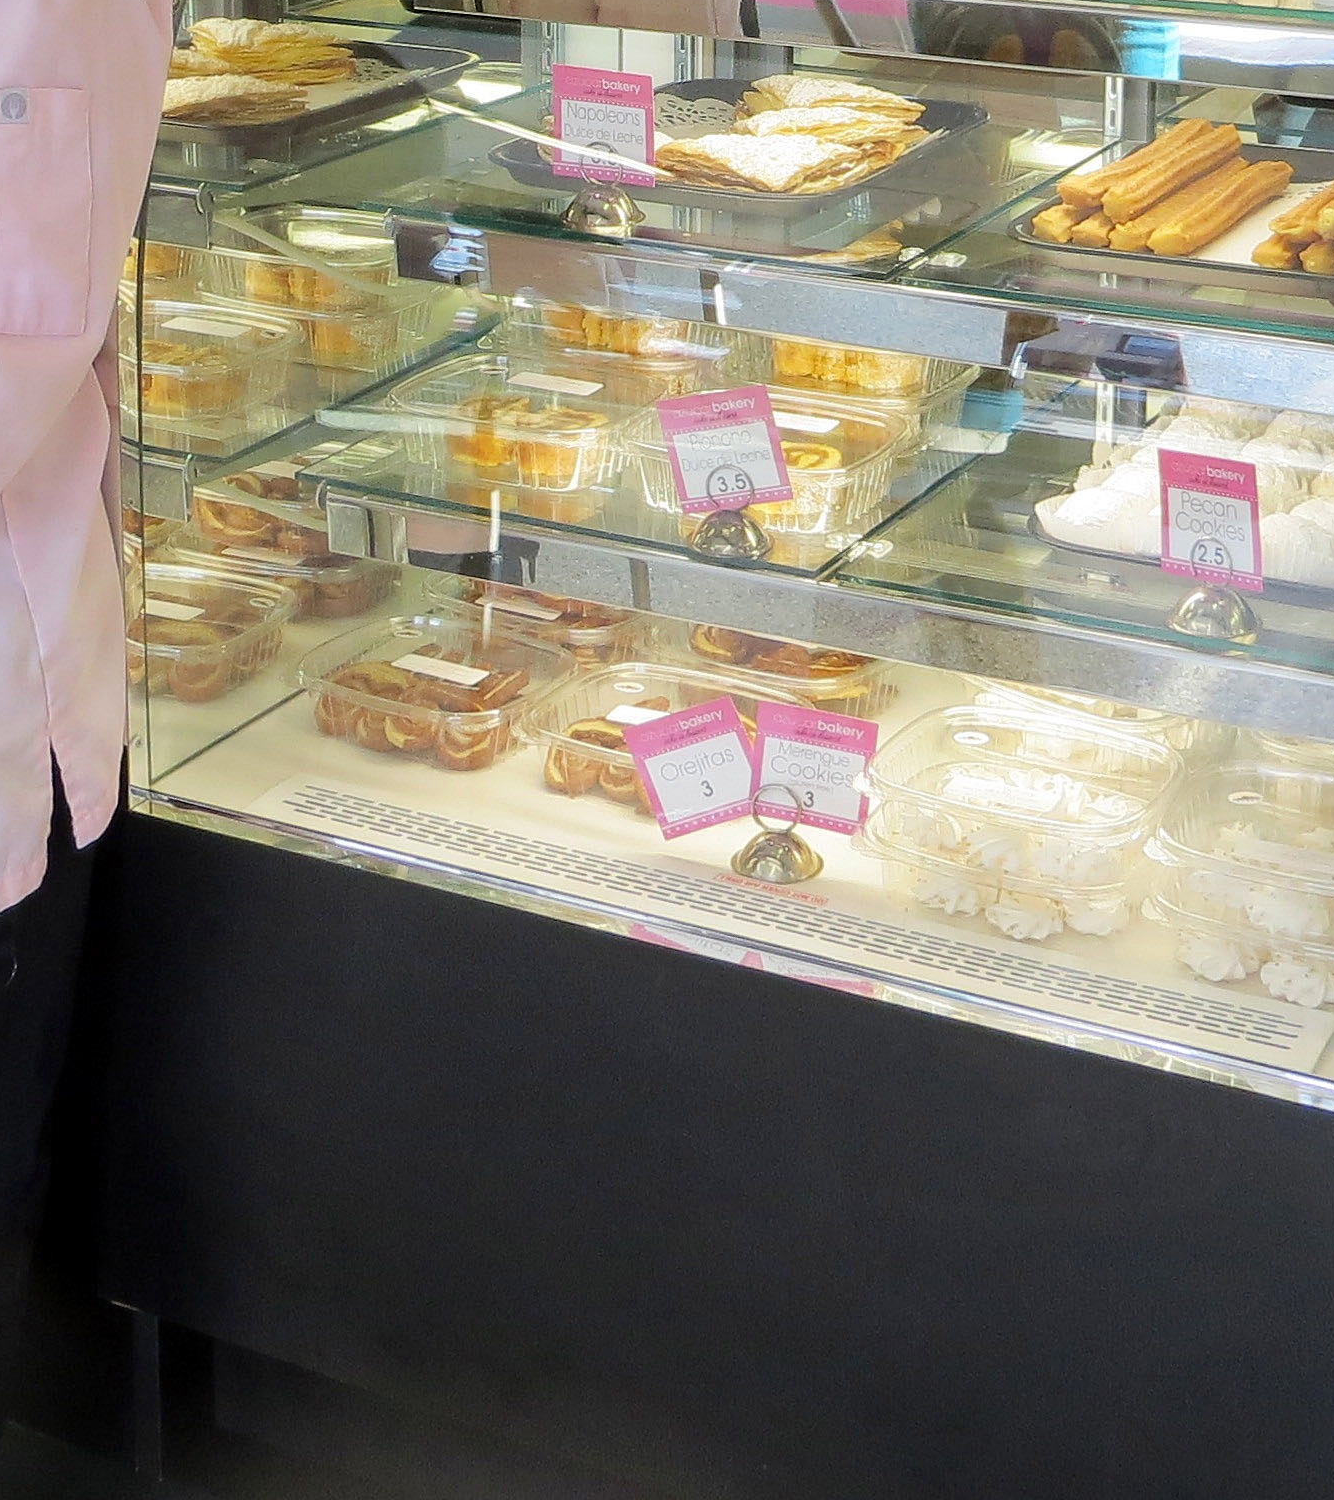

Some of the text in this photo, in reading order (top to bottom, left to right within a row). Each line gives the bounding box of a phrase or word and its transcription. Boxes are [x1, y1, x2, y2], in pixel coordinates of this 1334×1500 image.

[567, 101, 641, 127] Napoleons
[564, 122, 644, 145] Dulce de Leche
[681, 456, 715, 472] Dulce
[734, 448, 771, 466] Leche
[716, 472, 747, 493] 3.5
[1180, 490, 1238, 520] Pecan
[1175, 510, 1246, 542] Cookies
[1198, 543, 1224, 566] 2.5
[660, 747, 735, 782] Orejitas
[777, 740, 852, 768] Merengue
[770, 754, 855, 790] Cookies
[700, 779, 714, 798] 3
[802, 790, 815, 809] 3
